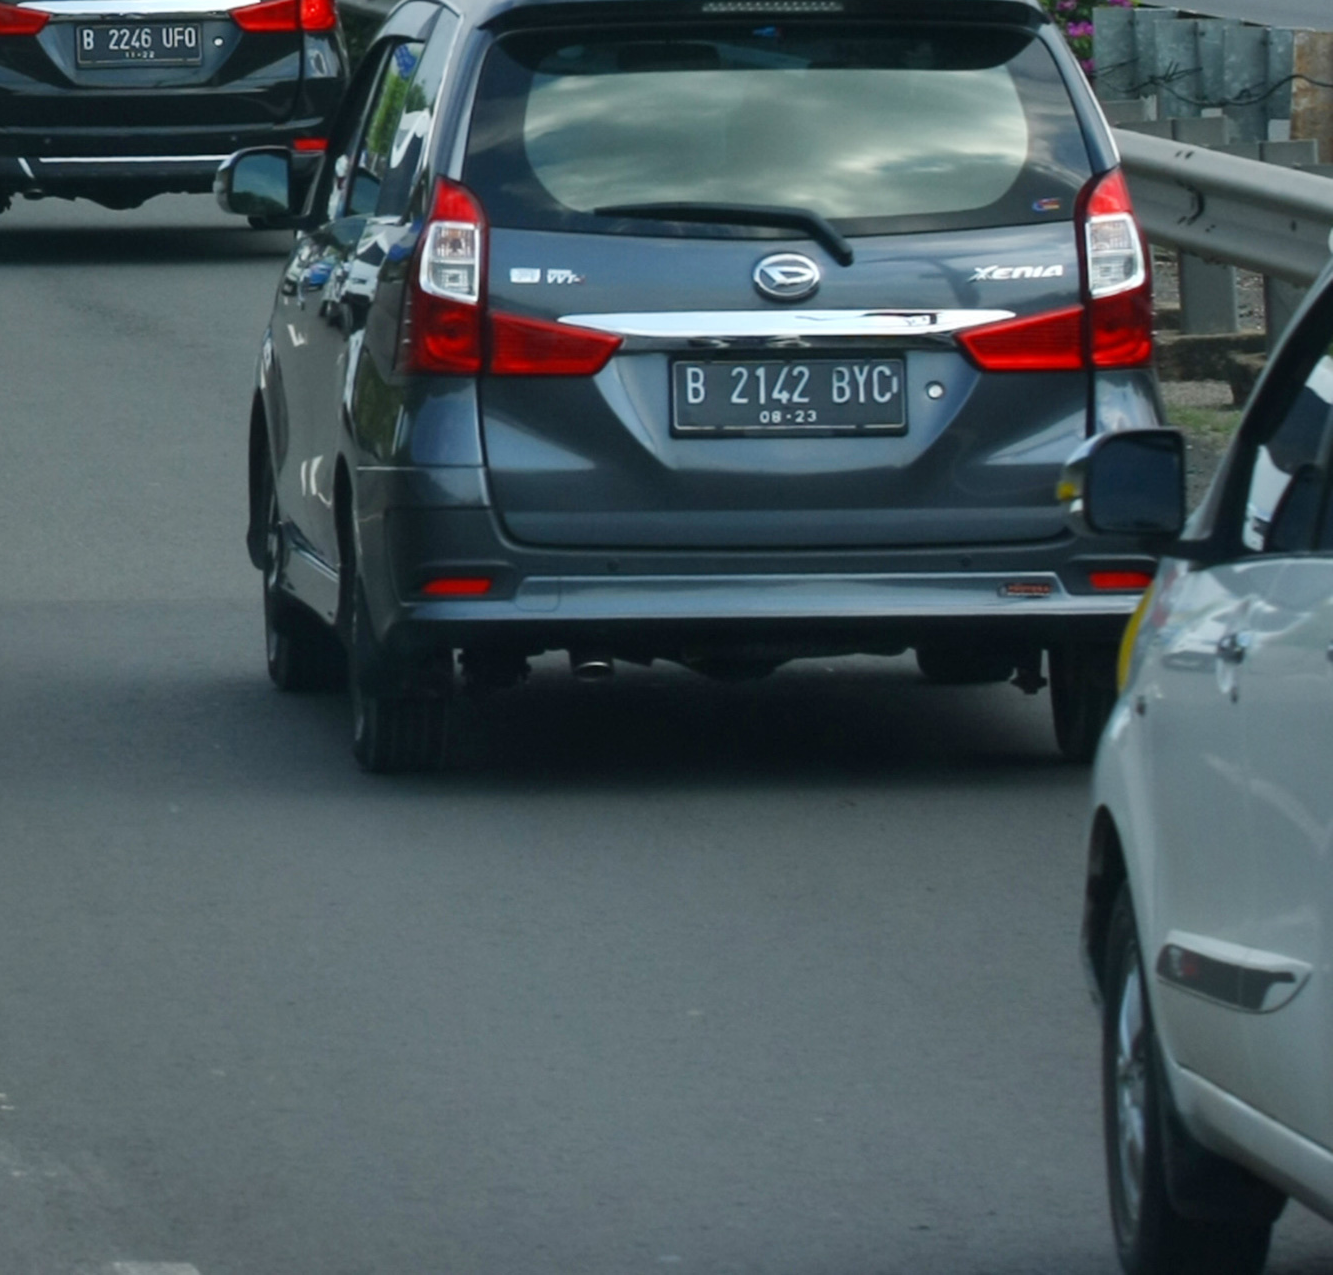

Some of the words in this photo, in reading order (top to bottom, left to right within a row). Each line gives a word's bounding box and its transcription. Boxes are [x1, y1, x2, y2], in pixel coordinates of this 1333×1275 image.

[83, 29, 94, 50] B
[108, 28, 152, 50] 2246
[162, 27, 196, 48] UFO
[685, 366, 706, 404] B
[730, 366, 811, 405] 2142
